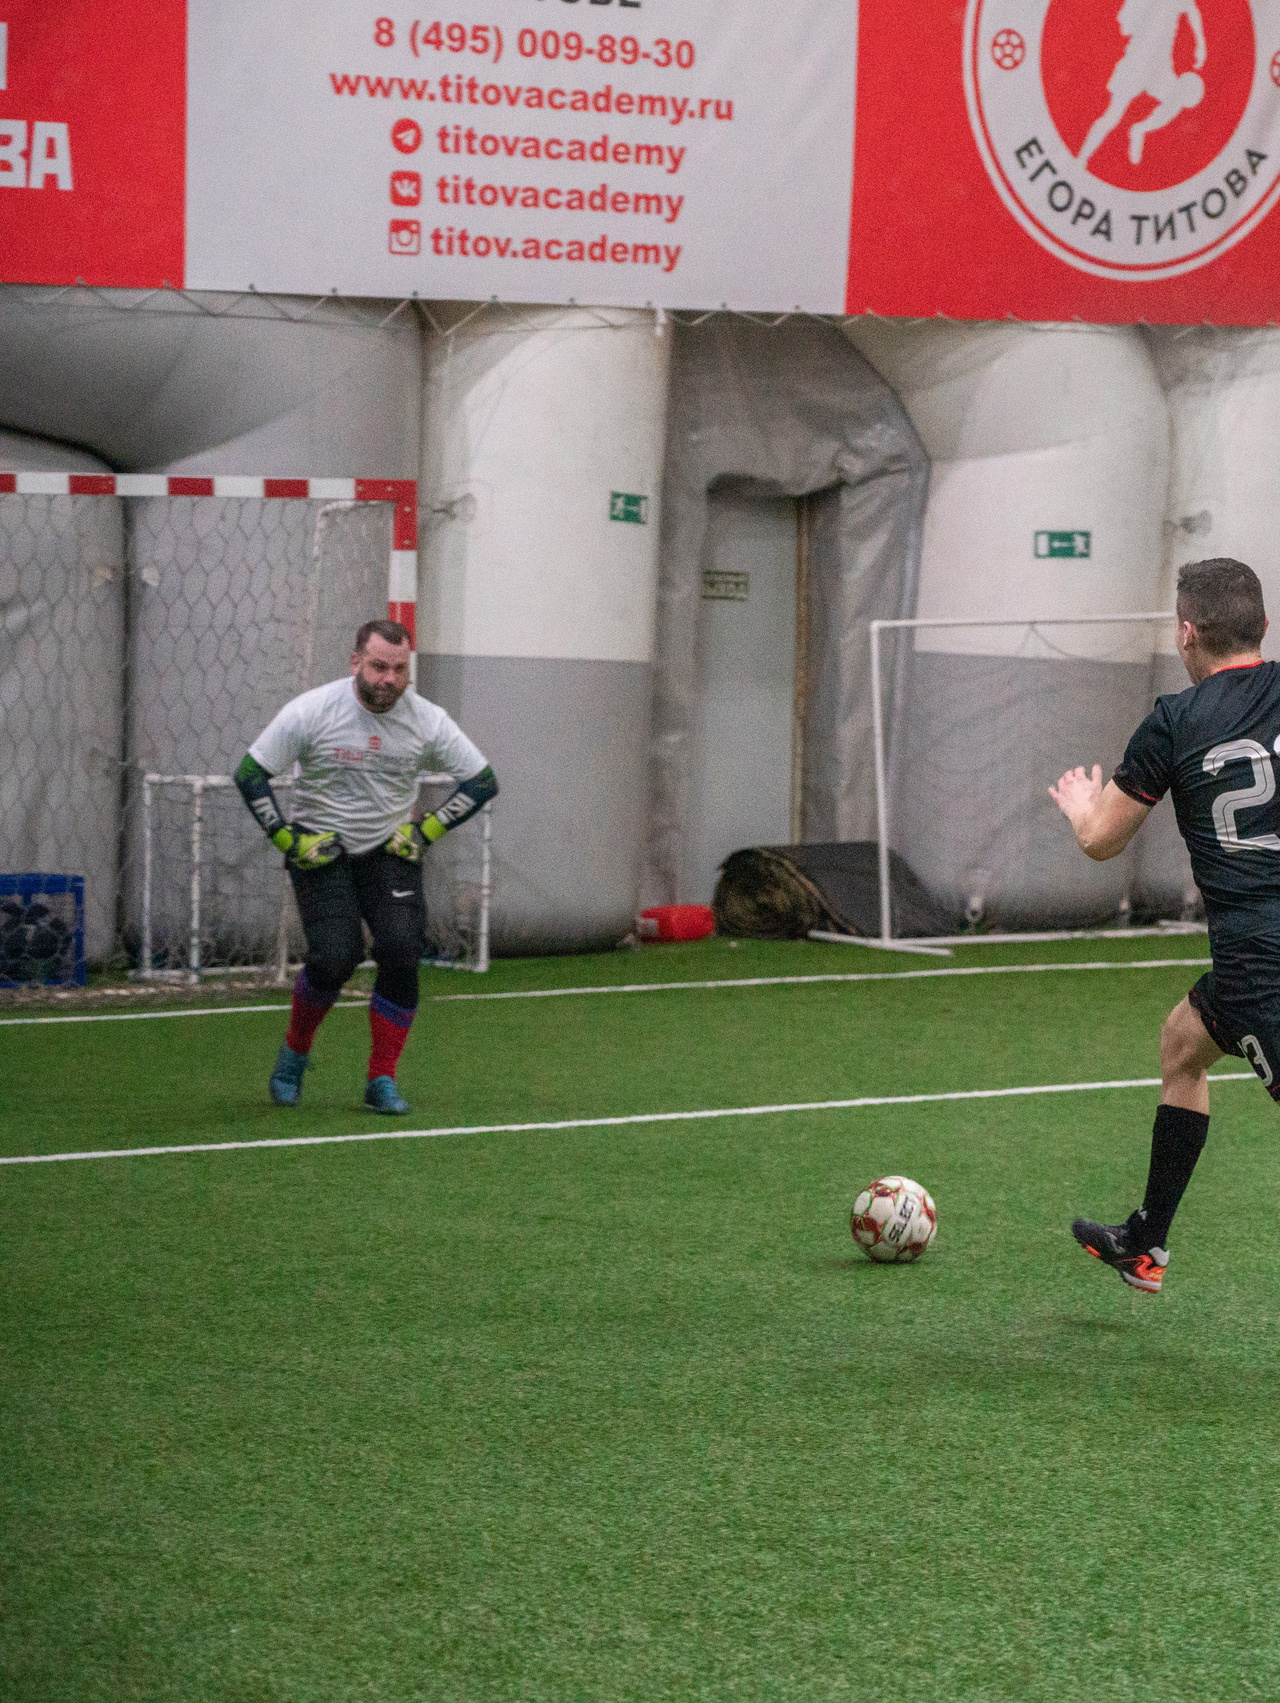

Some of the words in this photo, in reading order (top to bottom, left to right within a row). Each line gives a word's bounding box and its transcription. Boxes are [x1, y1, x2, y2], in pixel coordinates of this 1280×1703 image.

[374, 17, 395, 49] 8
[409, 20, 504, 64] (495)
[517, 27, 696, 70] 009-89-30
[330, 73, 734, 126] www.titovacademy.ru
[437, 124, 686, 175] titovacademy
[437, 174, 684, 224] titovacademy
[1014, 136, 1113, 242] ЕГОРА
[1129, 148, 1268, 245] ТИТОВА
[429, 226, 682, 274] titov.academy
[1237, 1034, 1273, 1087] 3
